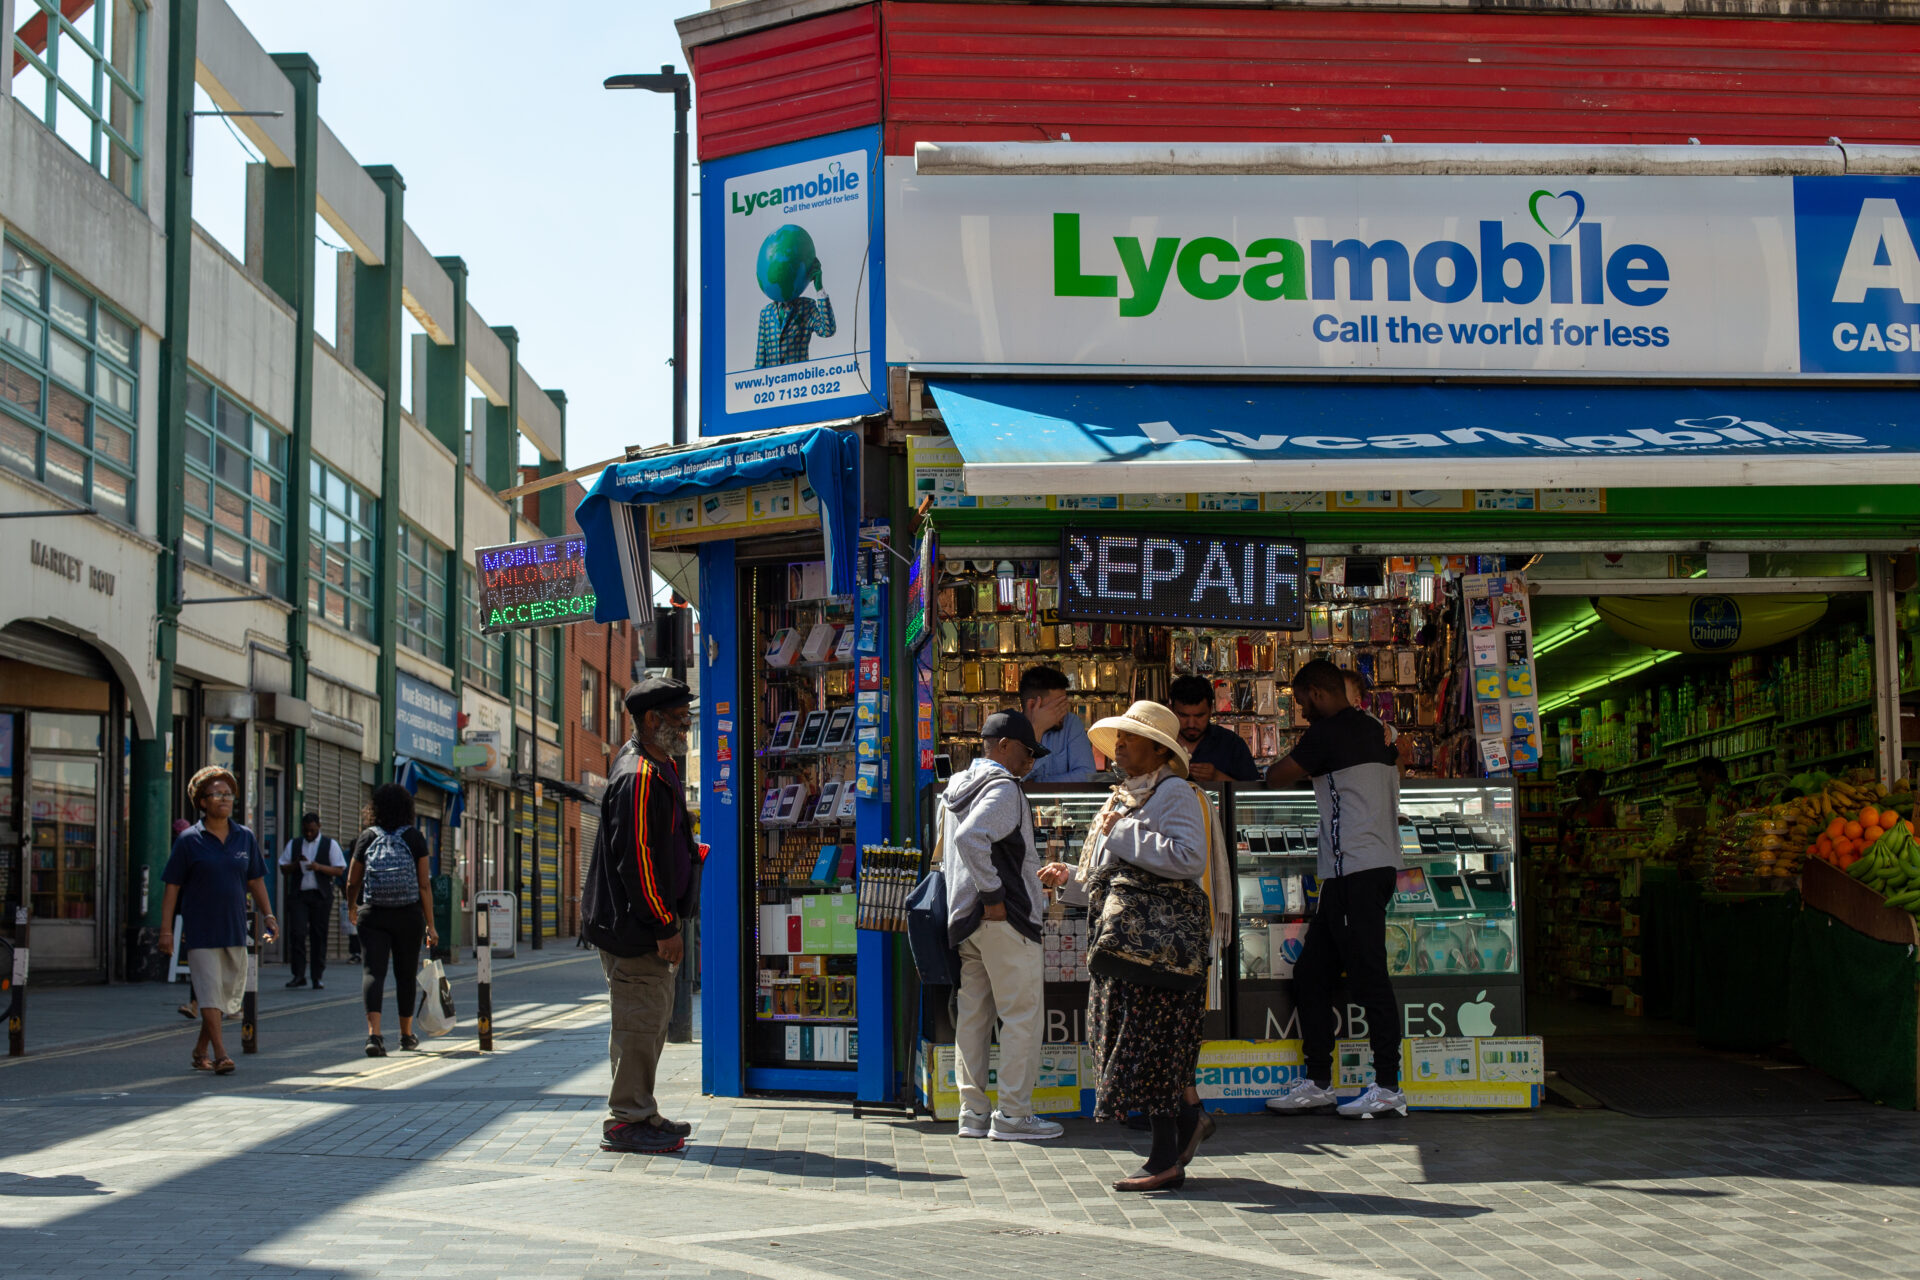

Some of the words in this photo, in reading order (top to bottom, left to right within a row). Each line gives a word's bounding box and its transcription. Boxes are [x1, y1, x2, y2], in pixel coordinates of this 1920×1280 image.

[732, 169, 859, 216] Lycamobile
[783, 203, 797, 214] Call
[798, 201, 811, 211] the
[811, 196, 832, 209] world
[832, 194, 843, 204] for
[844, 192, 859, 203] less
[1053, 212, 1671, 318] Lycamobile
[1312, 313, 1378, 344] Call
[1385, 315, 1442, 345] the
[1448, 317, 1543, 347] world
[1549, 318, 1599, 347] for
[1603, 318, 1671, 348] less
[734, 361, 860, 390] www.lycamobile.co.uk
[754, 391, 775, 404] 020
[778, 386, 808, 400] 7132
[810, 381, 841, 396] 0322
[644, 469, 660, 483] high
[659, 464, 683, 482] quality
[683, 457, 725, 475] International
[726, 455, 733, 466] &
[734, 452, 746, 465] UK
[764, 448, 780, 460] text
[780, 445, 786, 457] &
[786, 444, 799, 456] 4G
[30, 539, 83, 583] MARKET
[88, 565, 115, 596] ROW
[483, 544, 558, 571] MOBILE
[485, 558, 585, 588] UNLOCKIN
[487, 580, 572, 607] REPAIRS
[1692, 624, 1739, 643] Chiquita
[1395, 891, 1420, 901] Tab
[1265, 1003, 1446, 1039] MBES
[1223, 1087, 1243, 1097] Call
[1244, 1087, 1260, 1097] the
[1261, 1087, 1289, 1096] world
